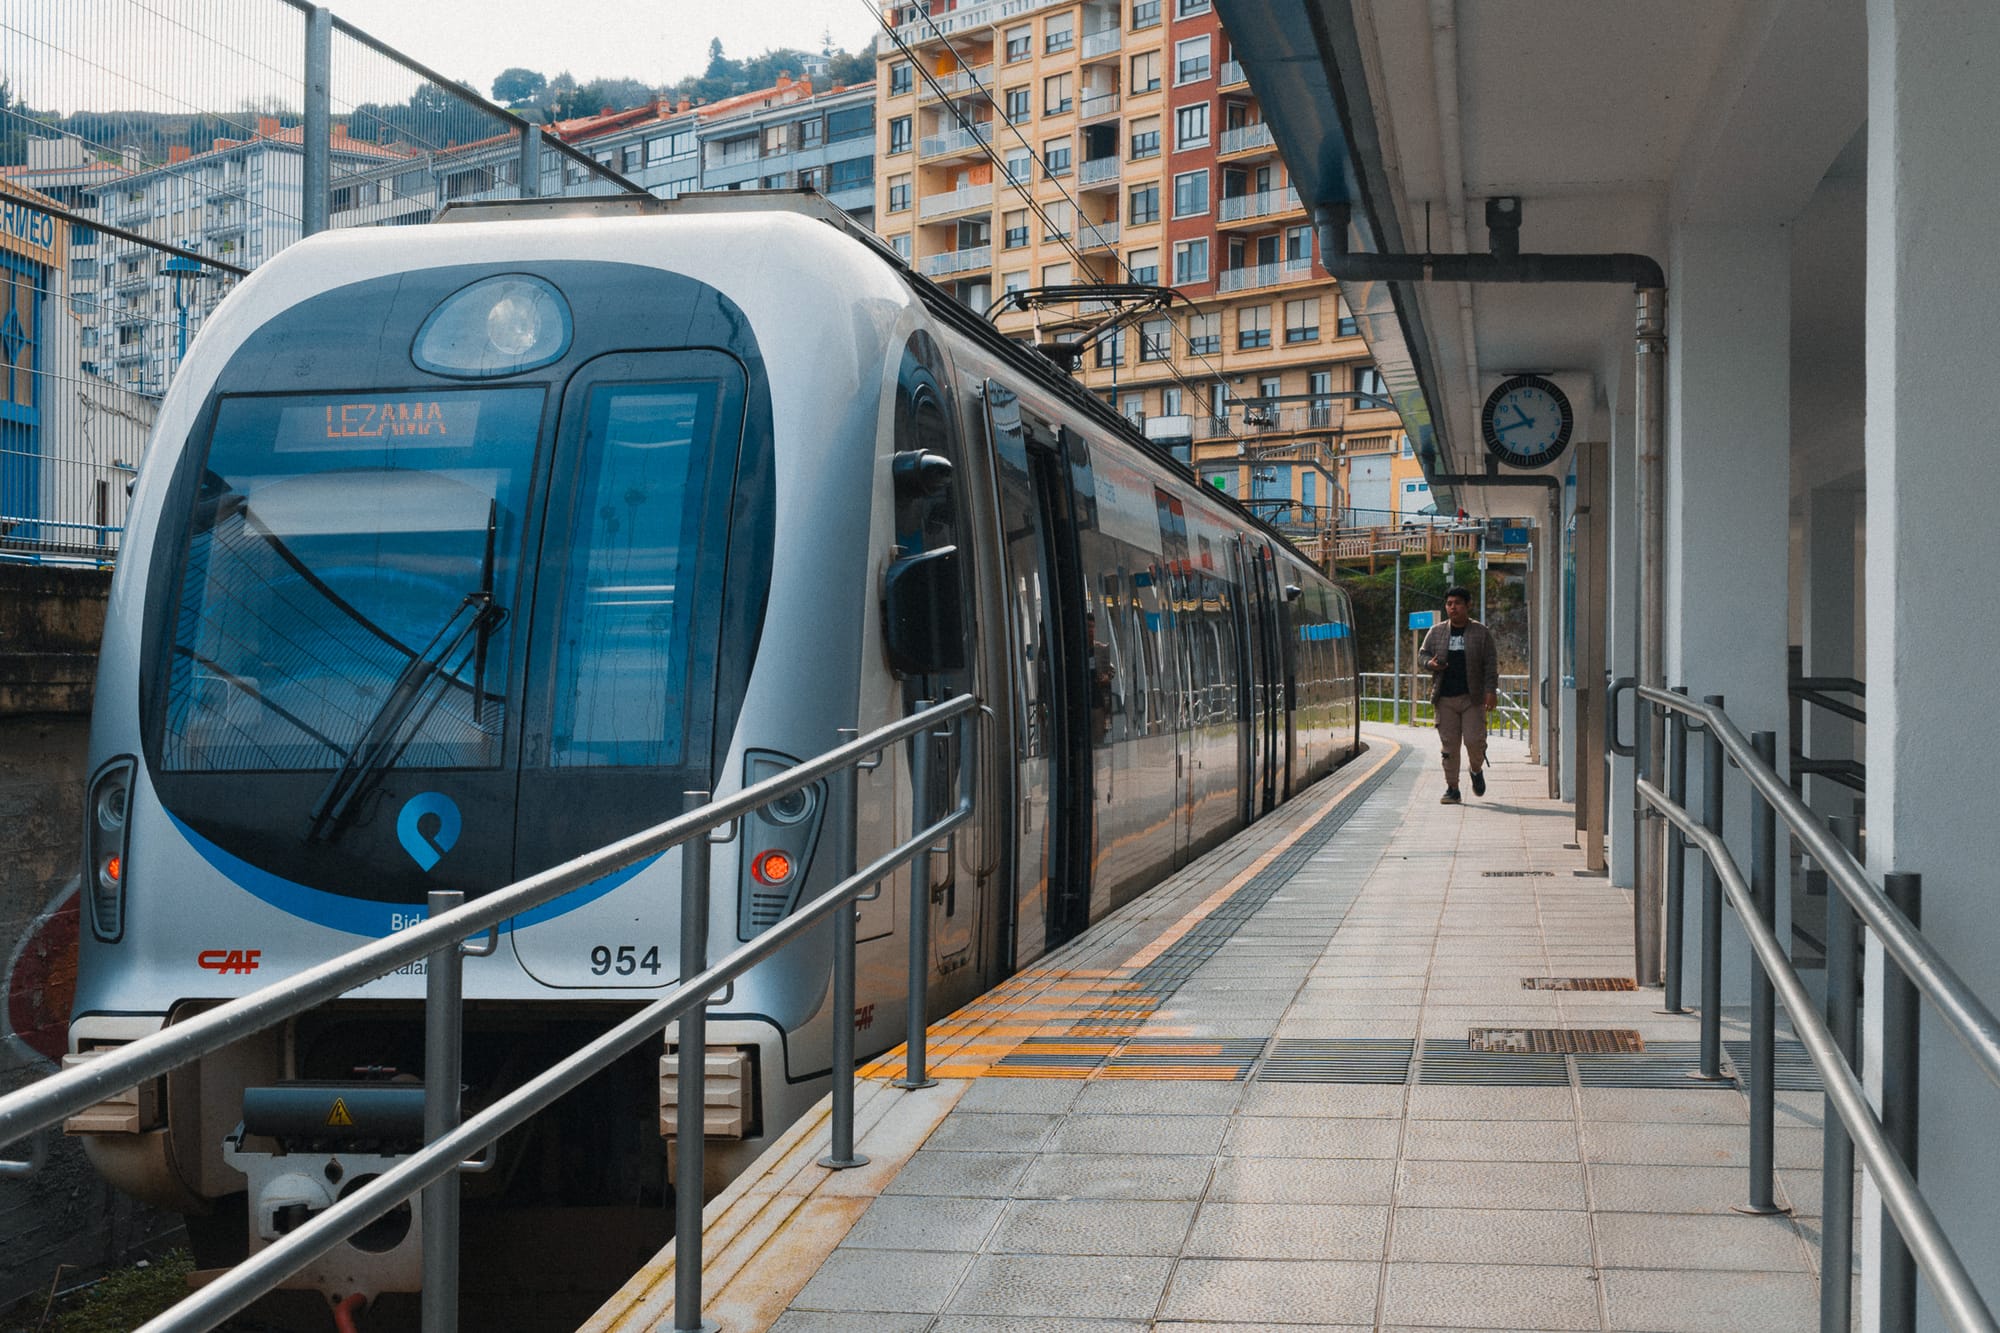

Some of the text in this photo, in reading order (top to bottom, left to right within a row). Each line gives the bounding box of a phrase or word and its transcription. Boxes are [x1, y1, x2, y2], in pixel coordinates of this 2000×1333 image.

[1523, 389, 1532, 398] 12
[1509, 394, 1518, 403] 11
[1499, 404, 1508, 413] 10
[1550, 403, 1556, 412] 2
[326, 402, 447, 438] LEZAMA
[1524, 446, 1530, 455] 6
[391, 913, 427, 931] Bid
[197, 950, 262, 974] CAF
[591, 945, 662, 976] 954
